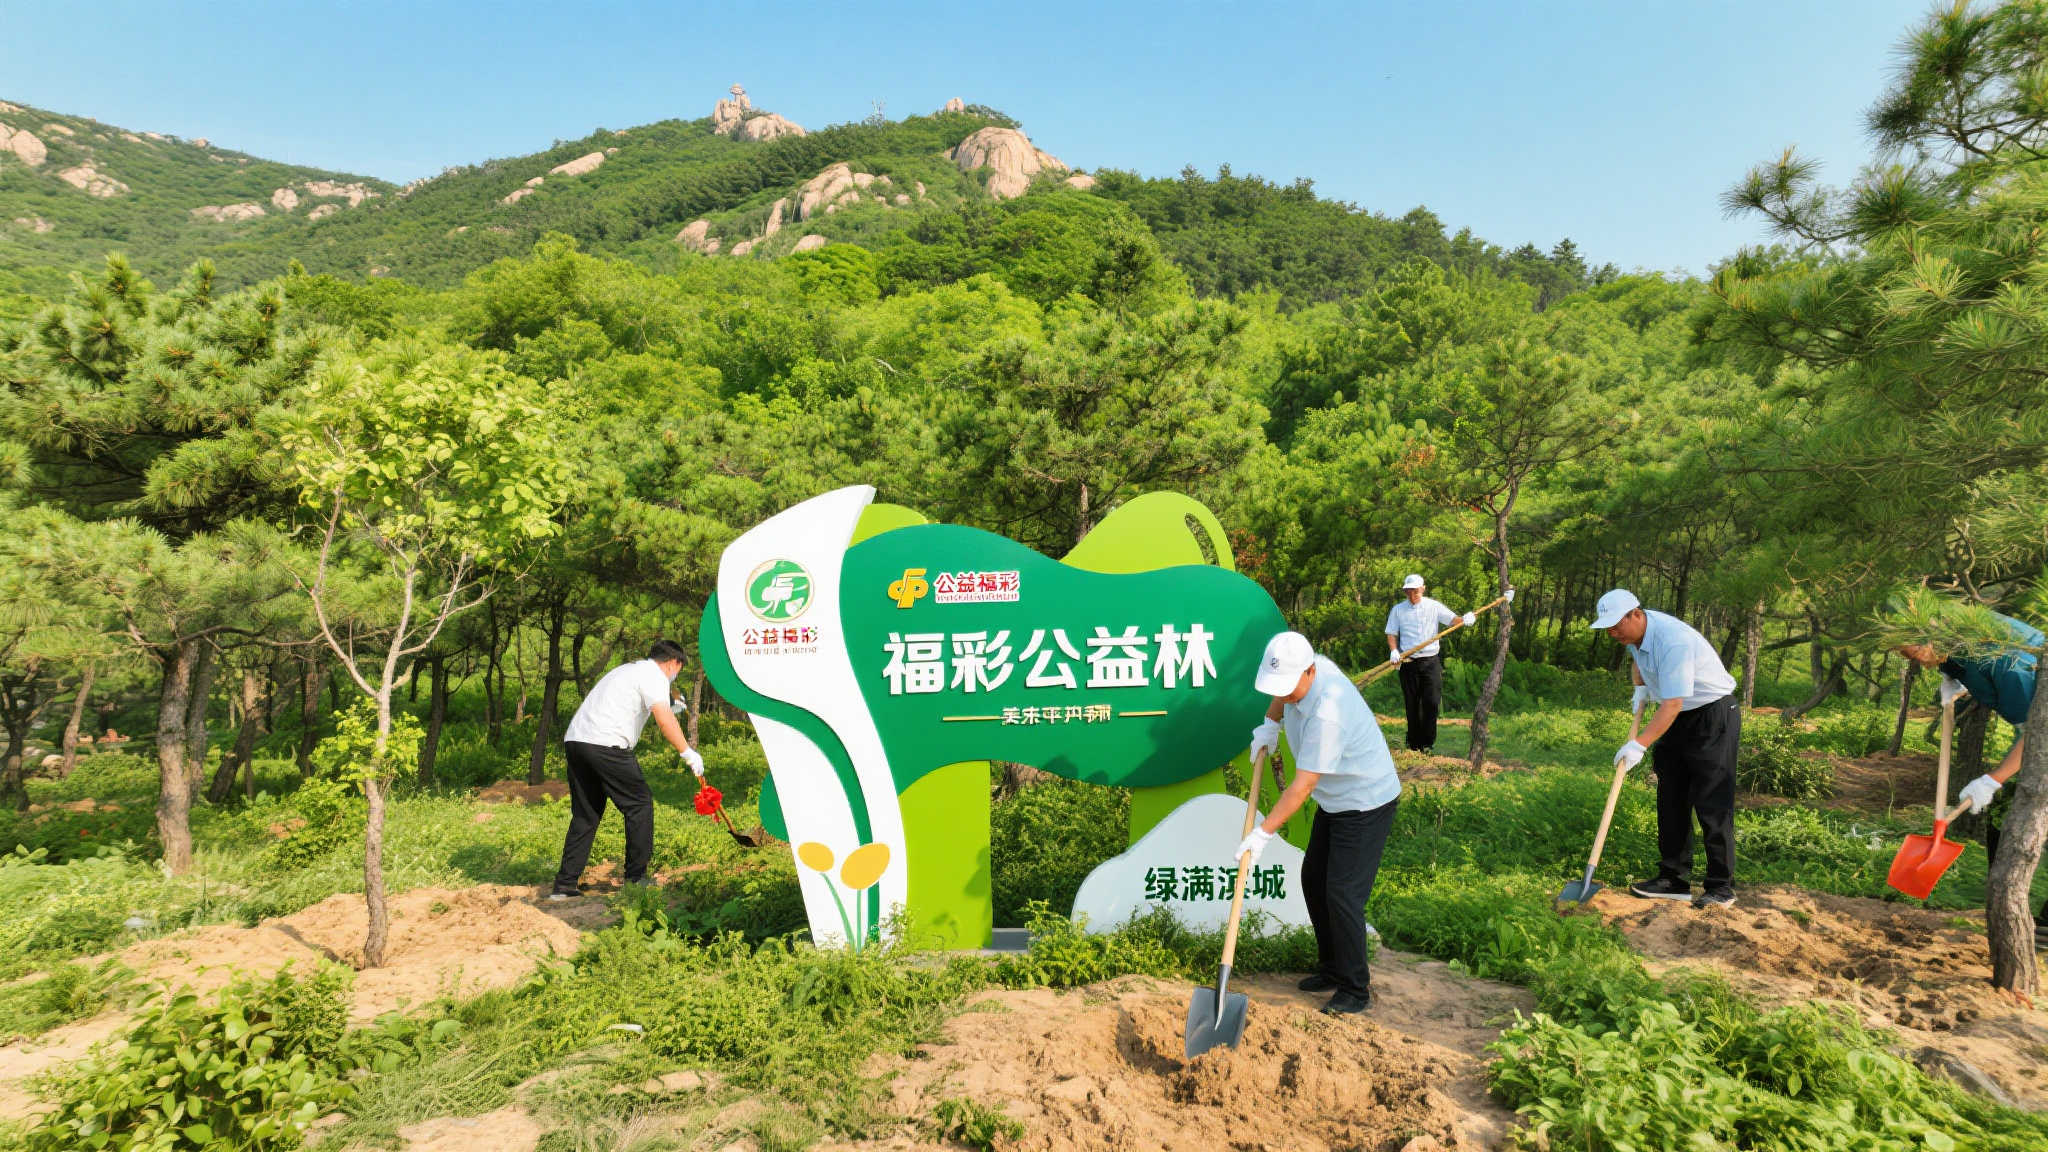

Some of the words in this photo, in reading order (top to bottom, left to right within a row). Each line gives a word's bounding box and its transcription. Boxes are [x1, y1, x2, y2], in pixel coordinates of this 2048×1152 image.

[882, 623, 1217, 695] 福彩公益林
